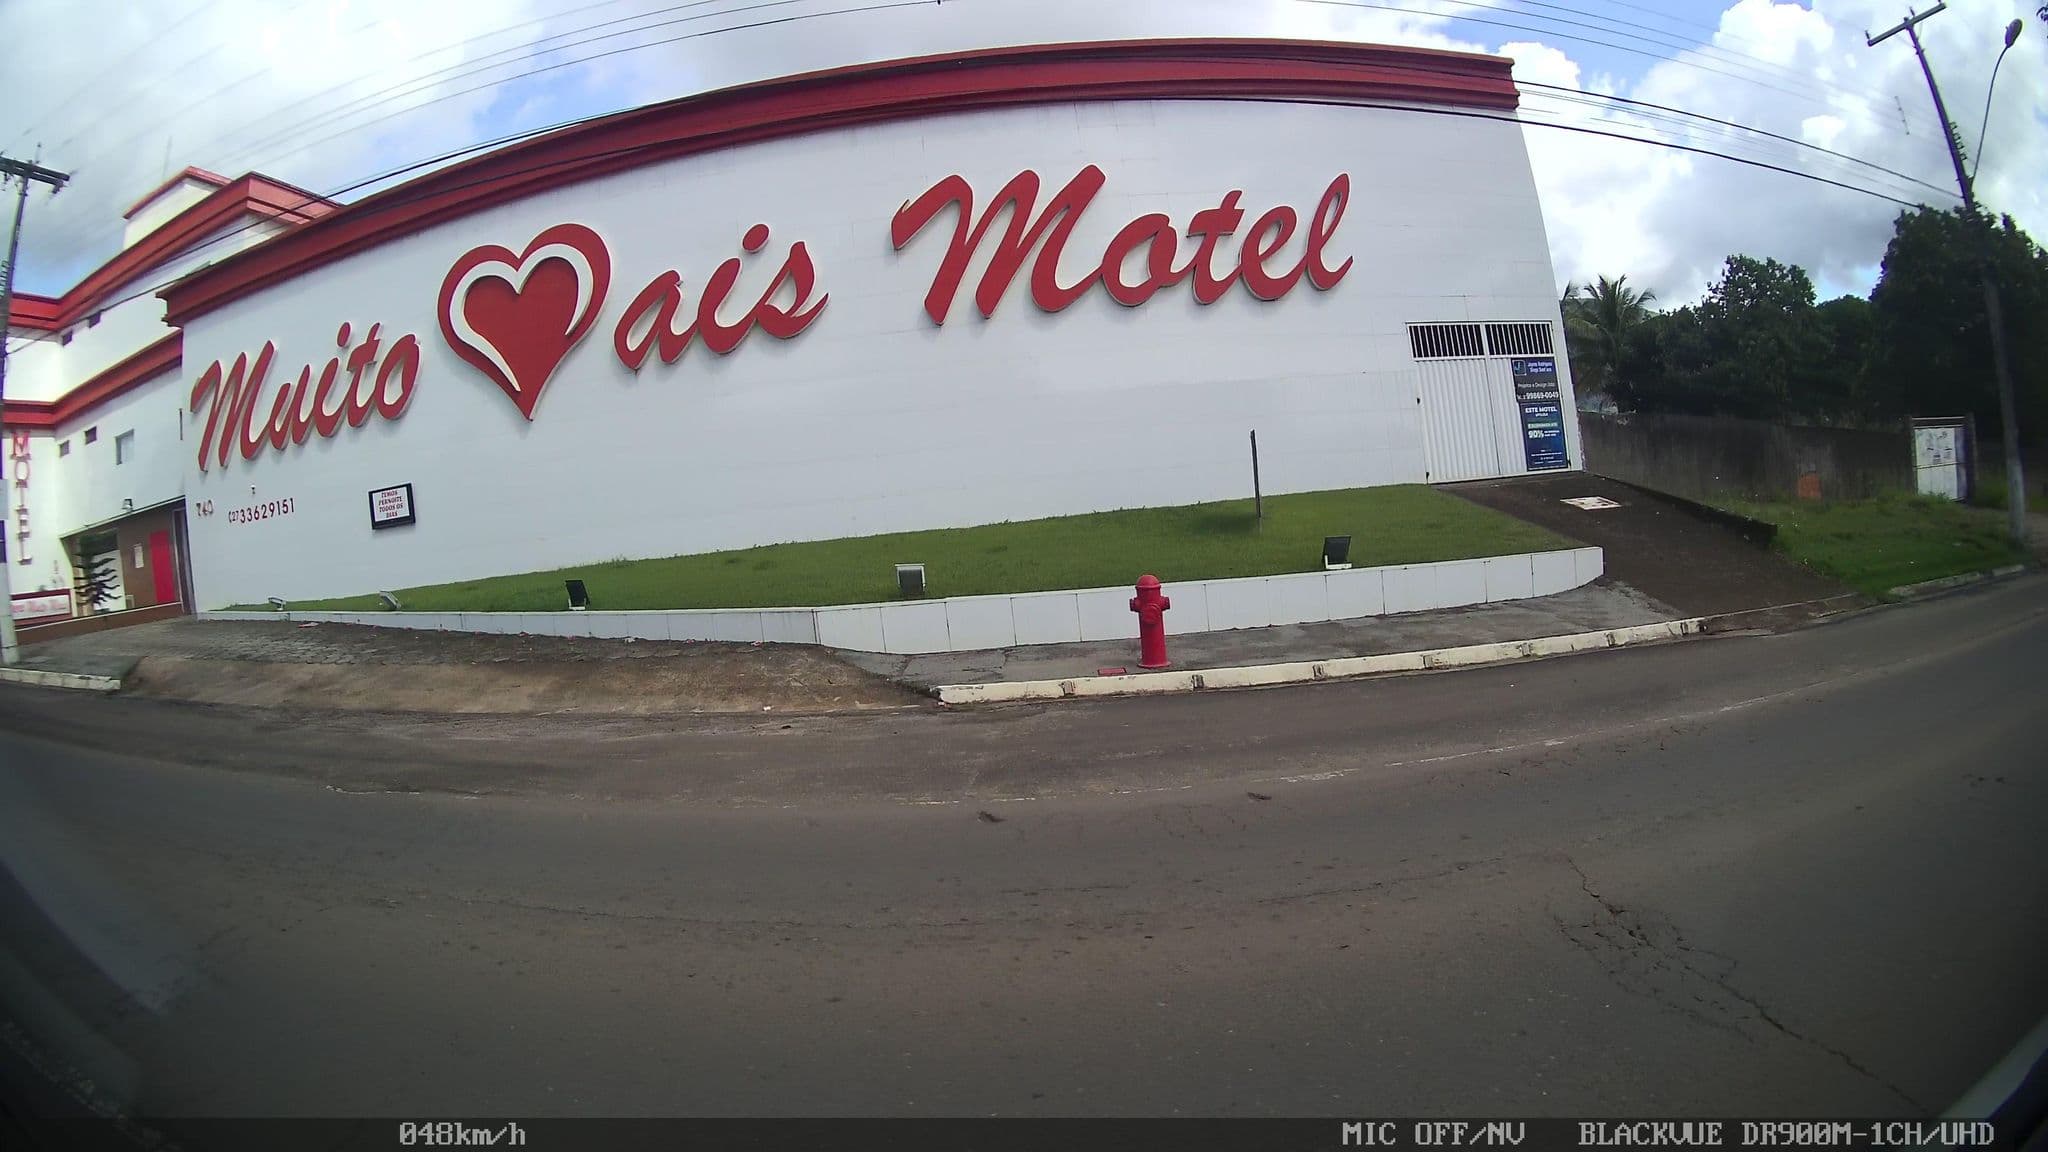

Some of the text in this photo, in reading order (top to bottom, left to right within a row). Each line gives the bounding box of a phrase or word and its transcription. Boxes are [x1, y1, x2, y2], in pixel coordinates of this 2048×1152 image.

[190, 322, 421, 472] Muito
[891, 164, 1354, 325] Motel
[10, 432, 33, 565] MOTEL
[1528, 430, 1544, 439] 90%
